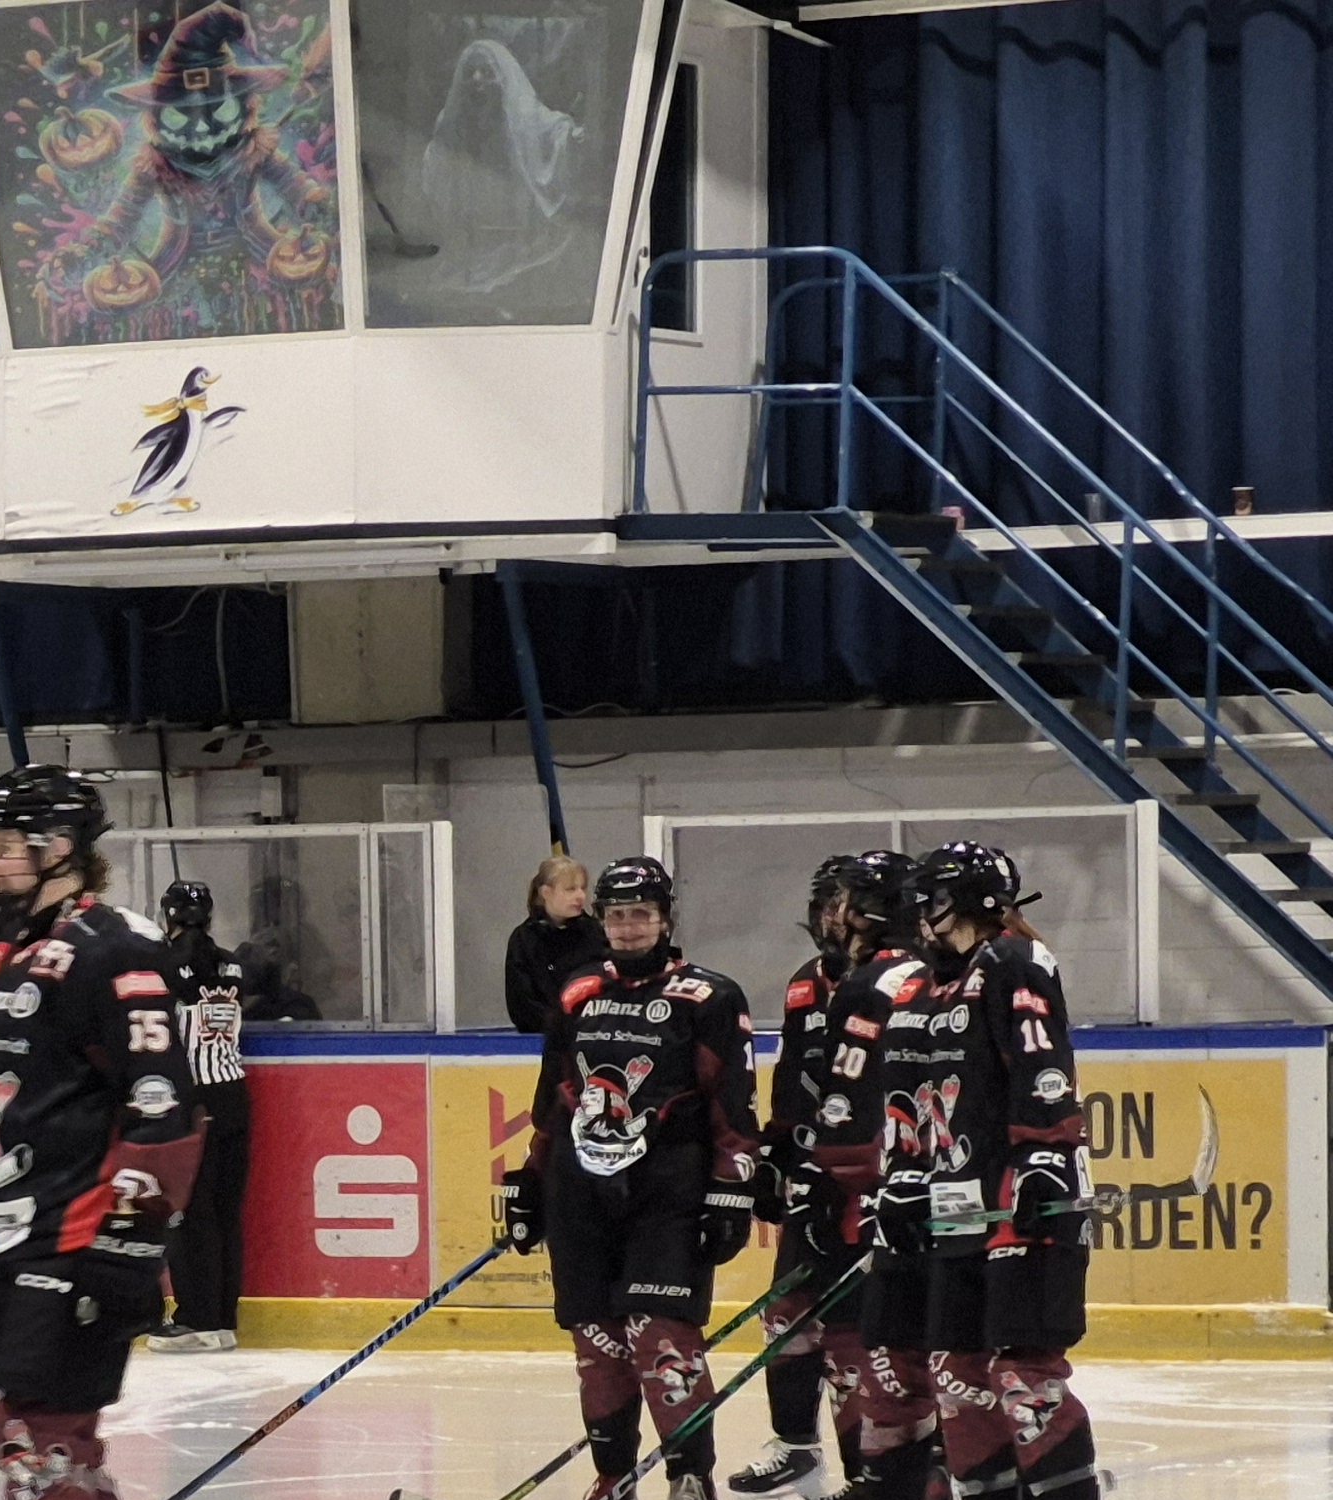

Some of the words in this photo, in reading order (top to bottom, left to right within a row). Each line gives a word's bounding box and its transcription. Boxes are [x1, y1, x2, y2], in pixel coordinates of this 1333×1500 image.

[581, 999, 643, 1018] Allianz
[128, 1009, 170, 1053] 15
[628, 1283, 692, 1298] BAUER
